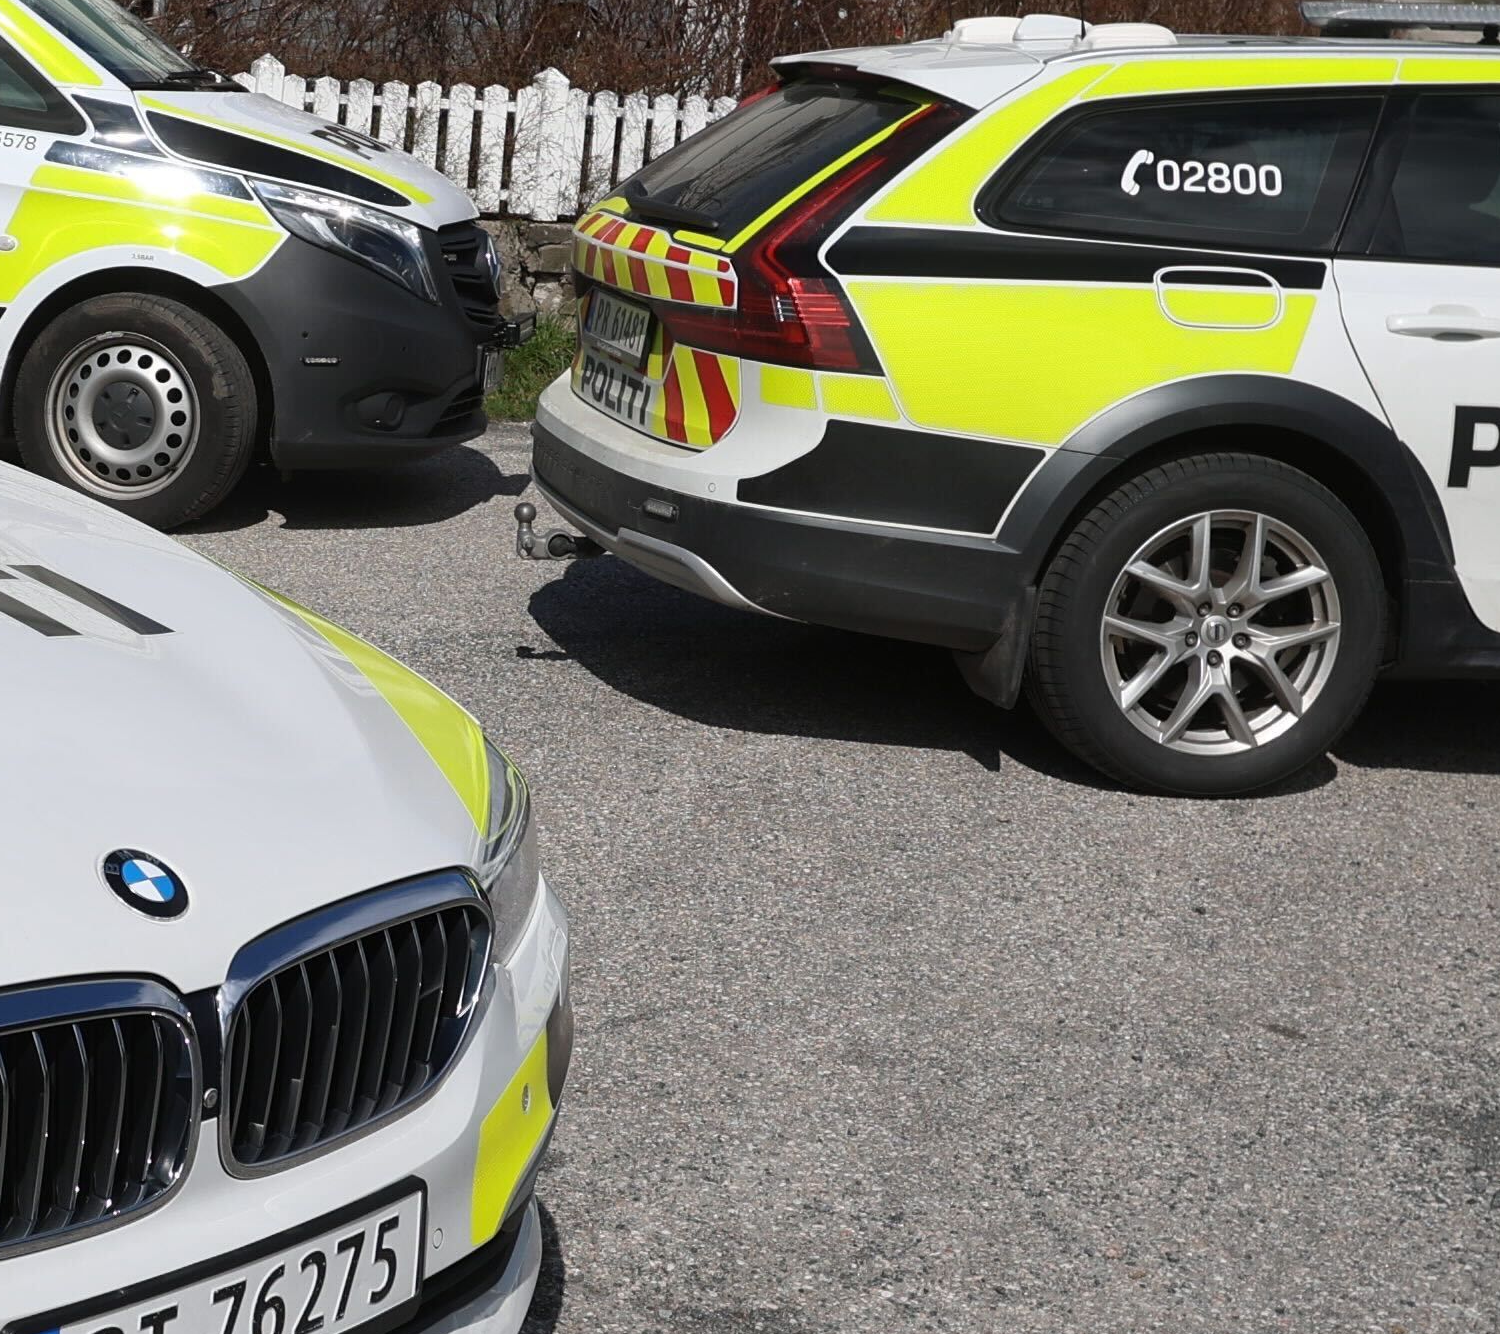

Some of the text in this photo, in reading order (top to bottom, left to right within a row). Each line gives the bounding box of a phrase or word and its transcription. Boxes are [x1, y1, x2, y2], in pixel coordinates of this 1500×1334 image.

[1156, 159, 1282, 196] 02800
[595, 298, 611, 336] PR
[580, 355, 651, 425] POLITI
